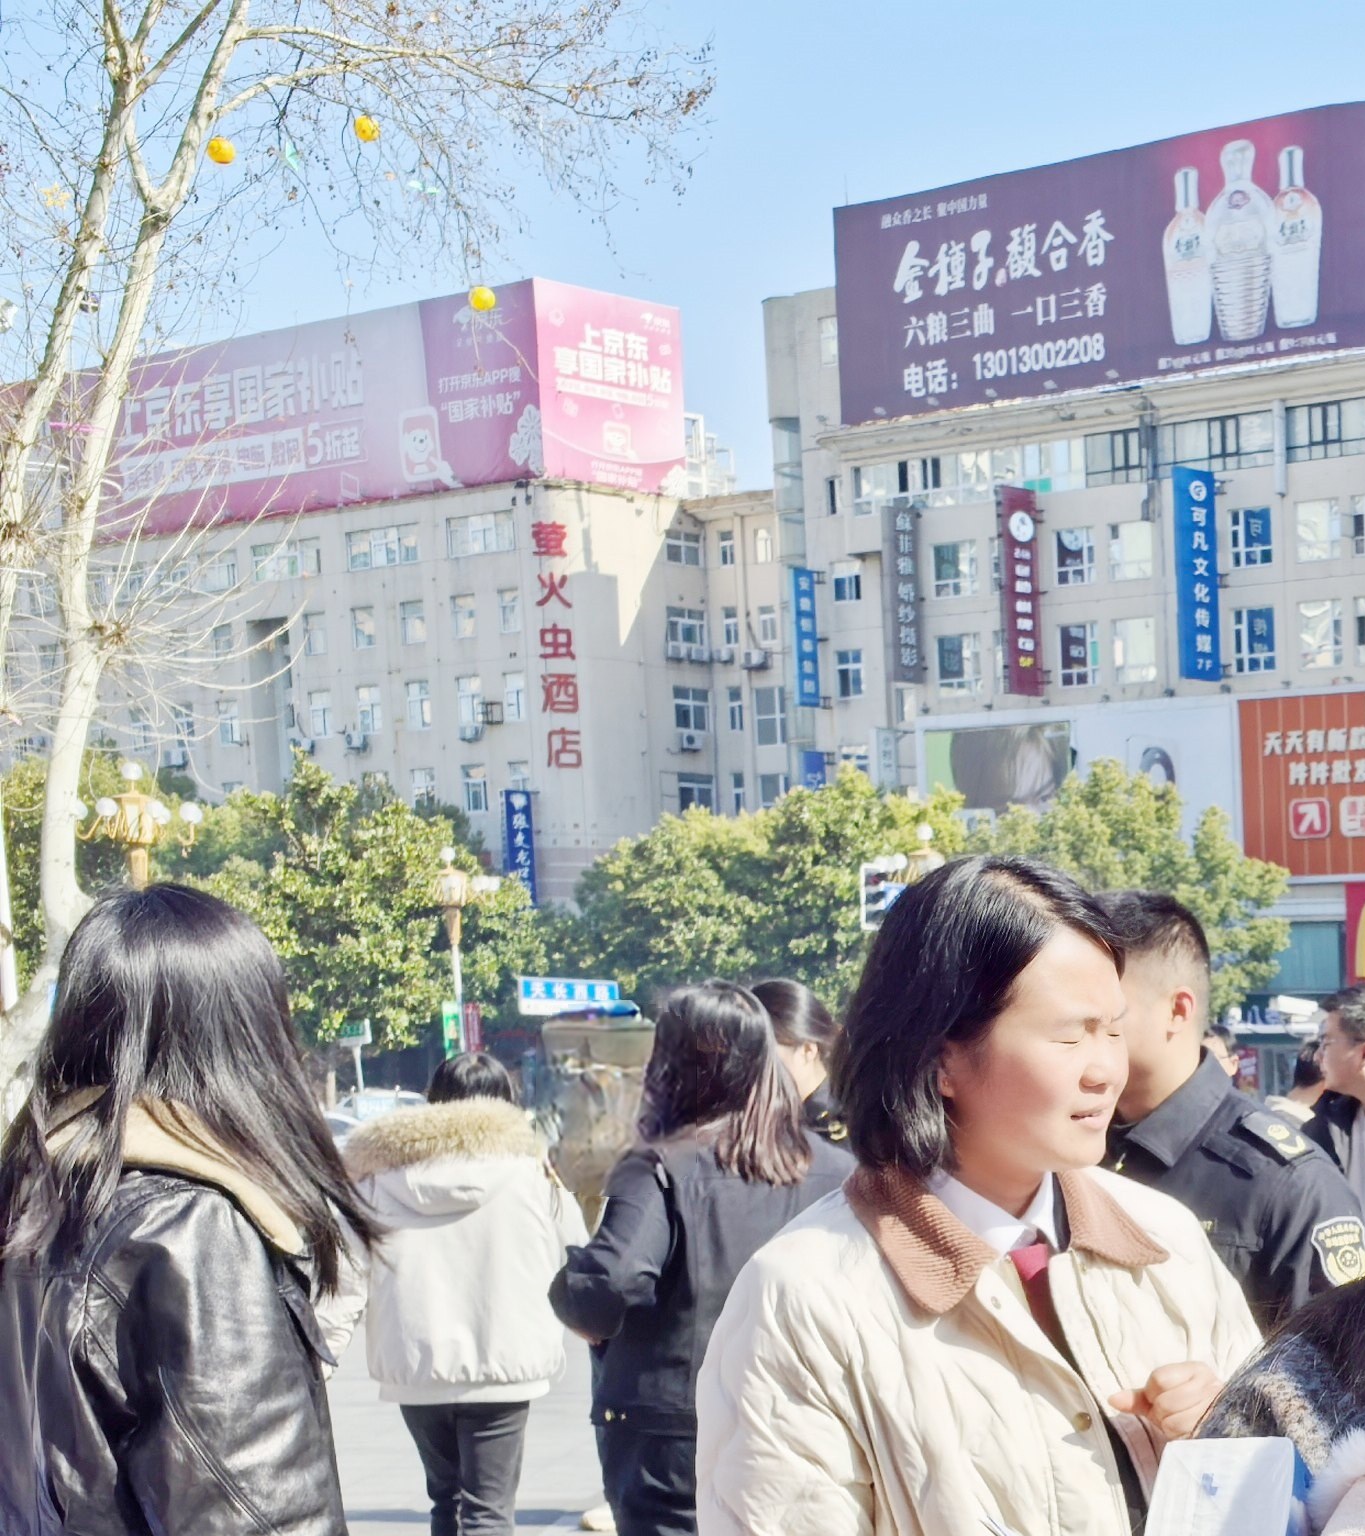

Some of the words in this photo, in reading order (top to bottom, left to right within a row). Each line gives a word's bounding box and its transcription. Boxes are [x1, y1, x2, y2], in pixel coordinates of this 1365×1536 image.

[578, 323, 648, 361] 上京东
[903, 303, 994, 348] 六粮三曲
[1010, 282, 1107, 326] 一口三香
[553, 346, 672, 394] 享国家补贴
[972, 332, 1106, 380] 13013002208
[1190, 506, 1213, 655] 可凡文化传媒
[530, 520, 584, 771] 萤火虫酒店
